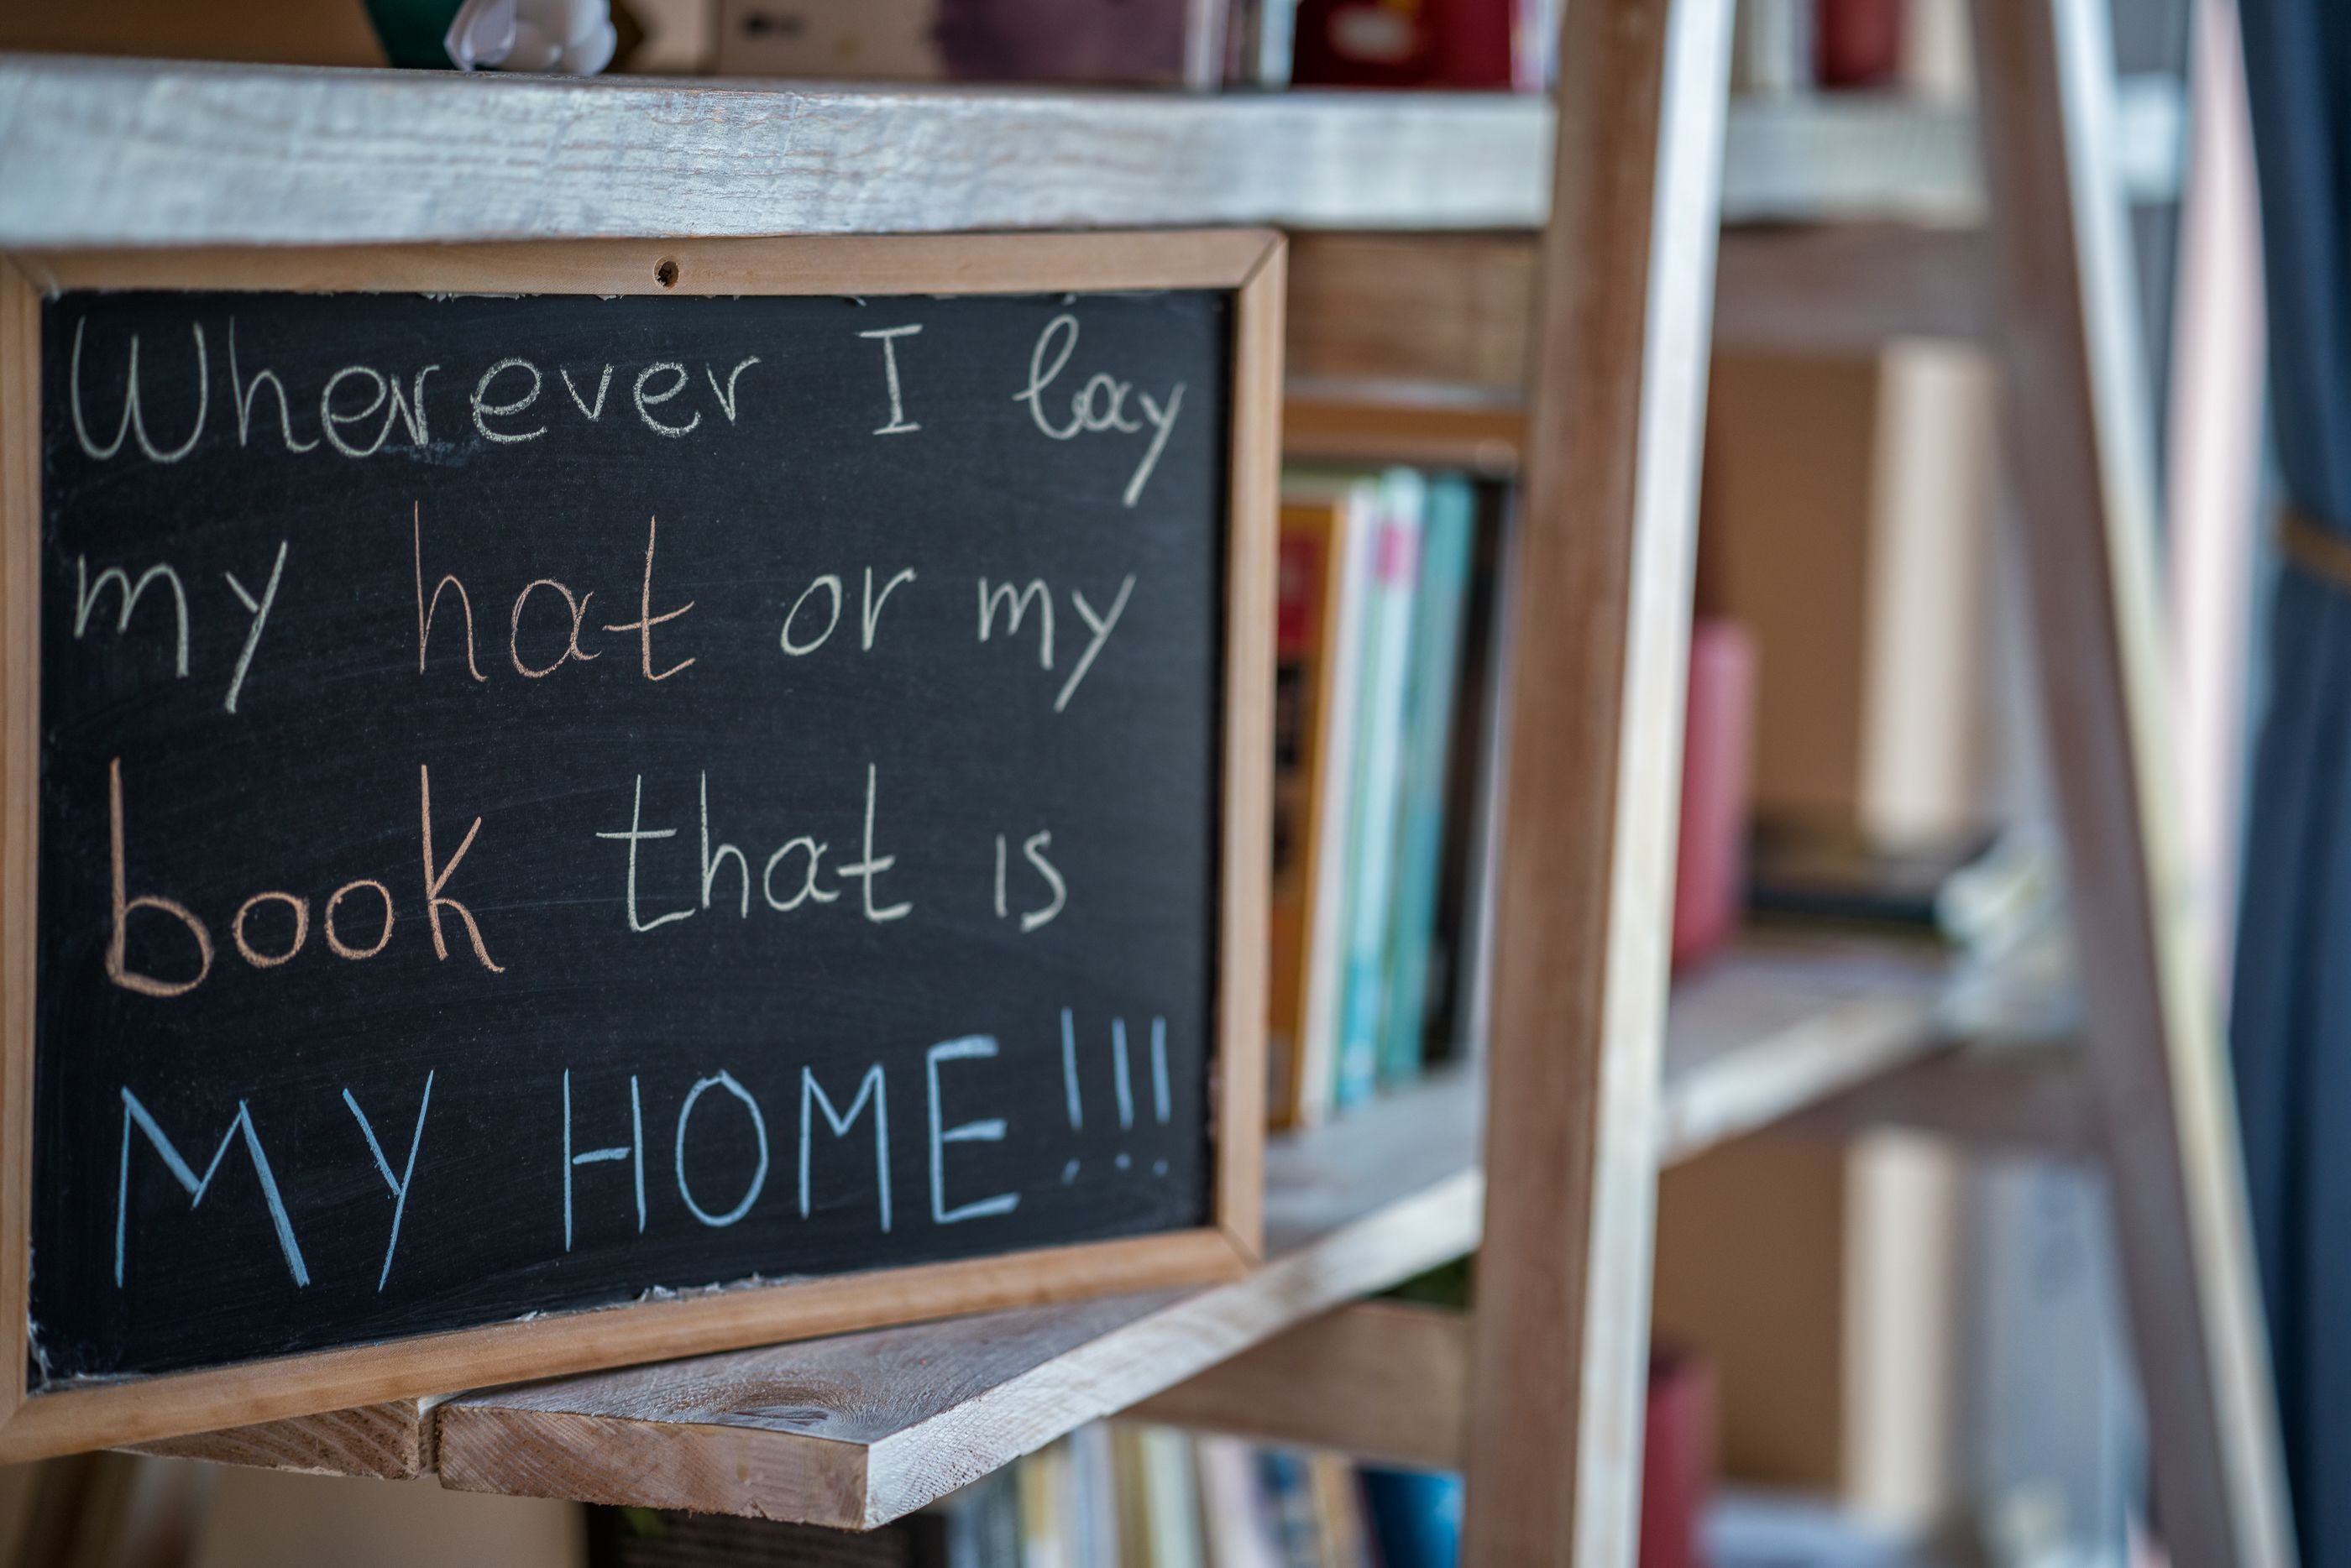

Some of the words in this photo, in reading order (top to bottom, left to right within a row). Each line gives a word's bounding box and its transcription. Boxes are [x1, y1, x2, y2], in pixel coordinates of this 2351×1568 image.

[71, 314, 762, 464] Wherever
[855, 322, 924, 436] I
[1012, 313, 1186, 508] lay
[72, 539, 289, 715] my
[412, 499, 698, 682] hat
[779, 565, 918, 657] or
[977, 573, 1138, 713] my
[104, 755, 505, 999] book
[594, 761, 914, 933] that
[993, 828, 1067, 934] is
[113, 1068, 436, 1295] MY
